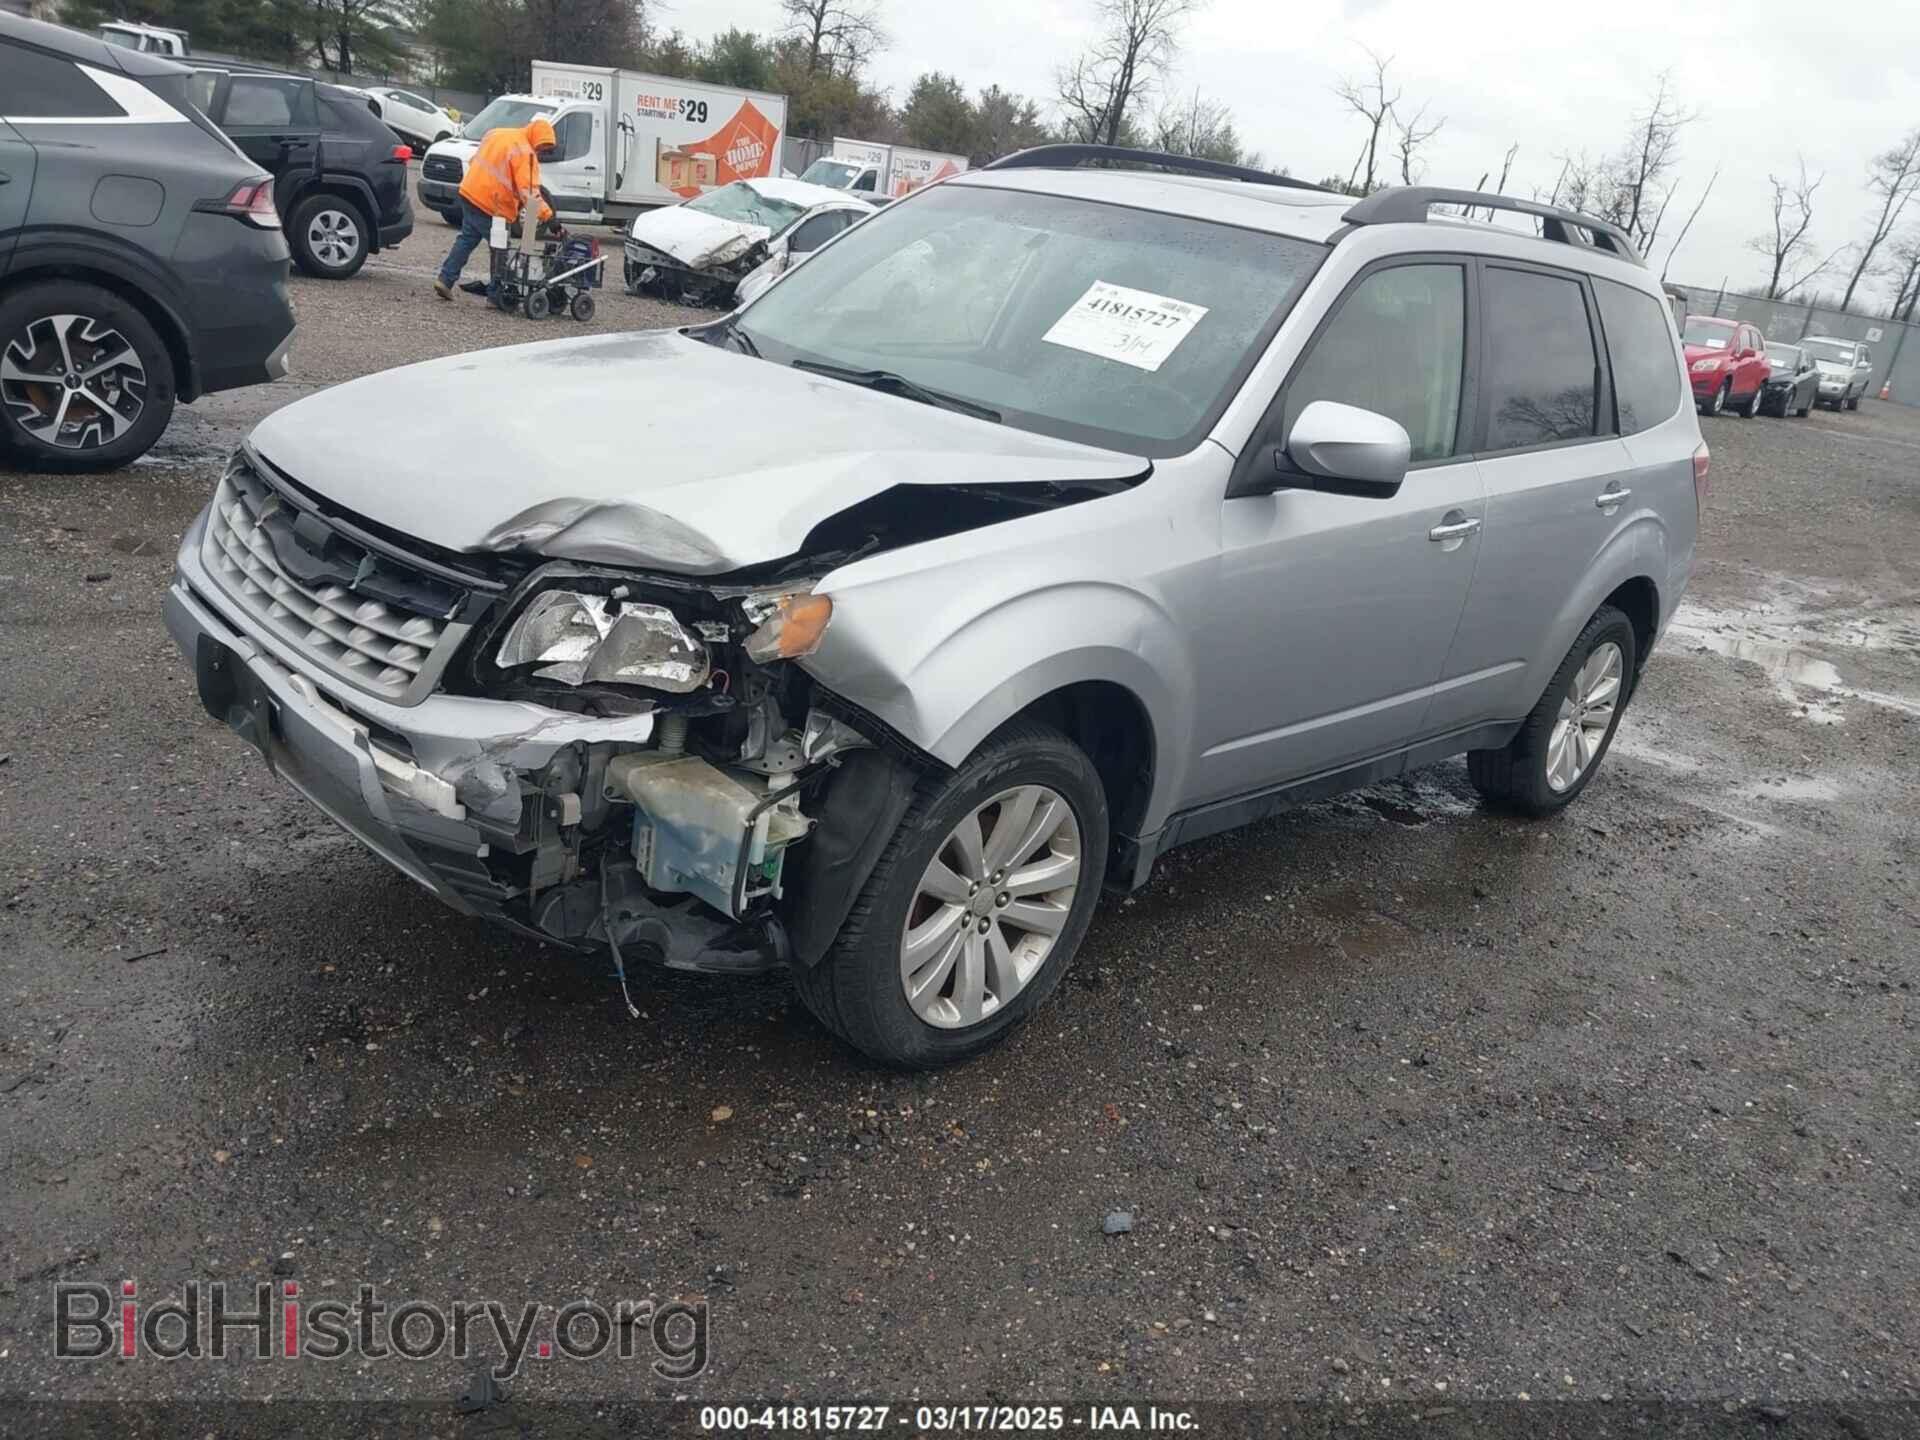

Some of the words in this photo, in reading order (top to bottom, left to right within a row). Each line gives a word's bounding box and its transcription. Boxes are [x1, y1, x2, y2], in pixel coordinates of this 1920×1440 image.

[582, 81, 602, 101] $29
[637, 94, 660, 109] RENT
[663, 97, 678, 112] ME
[679, 98, 708, 123] $29
[637, 108, 667, 120] STARTING
[727, 143, 764, 165] HOME
[1088, 298, 1181, 329] 41815727
